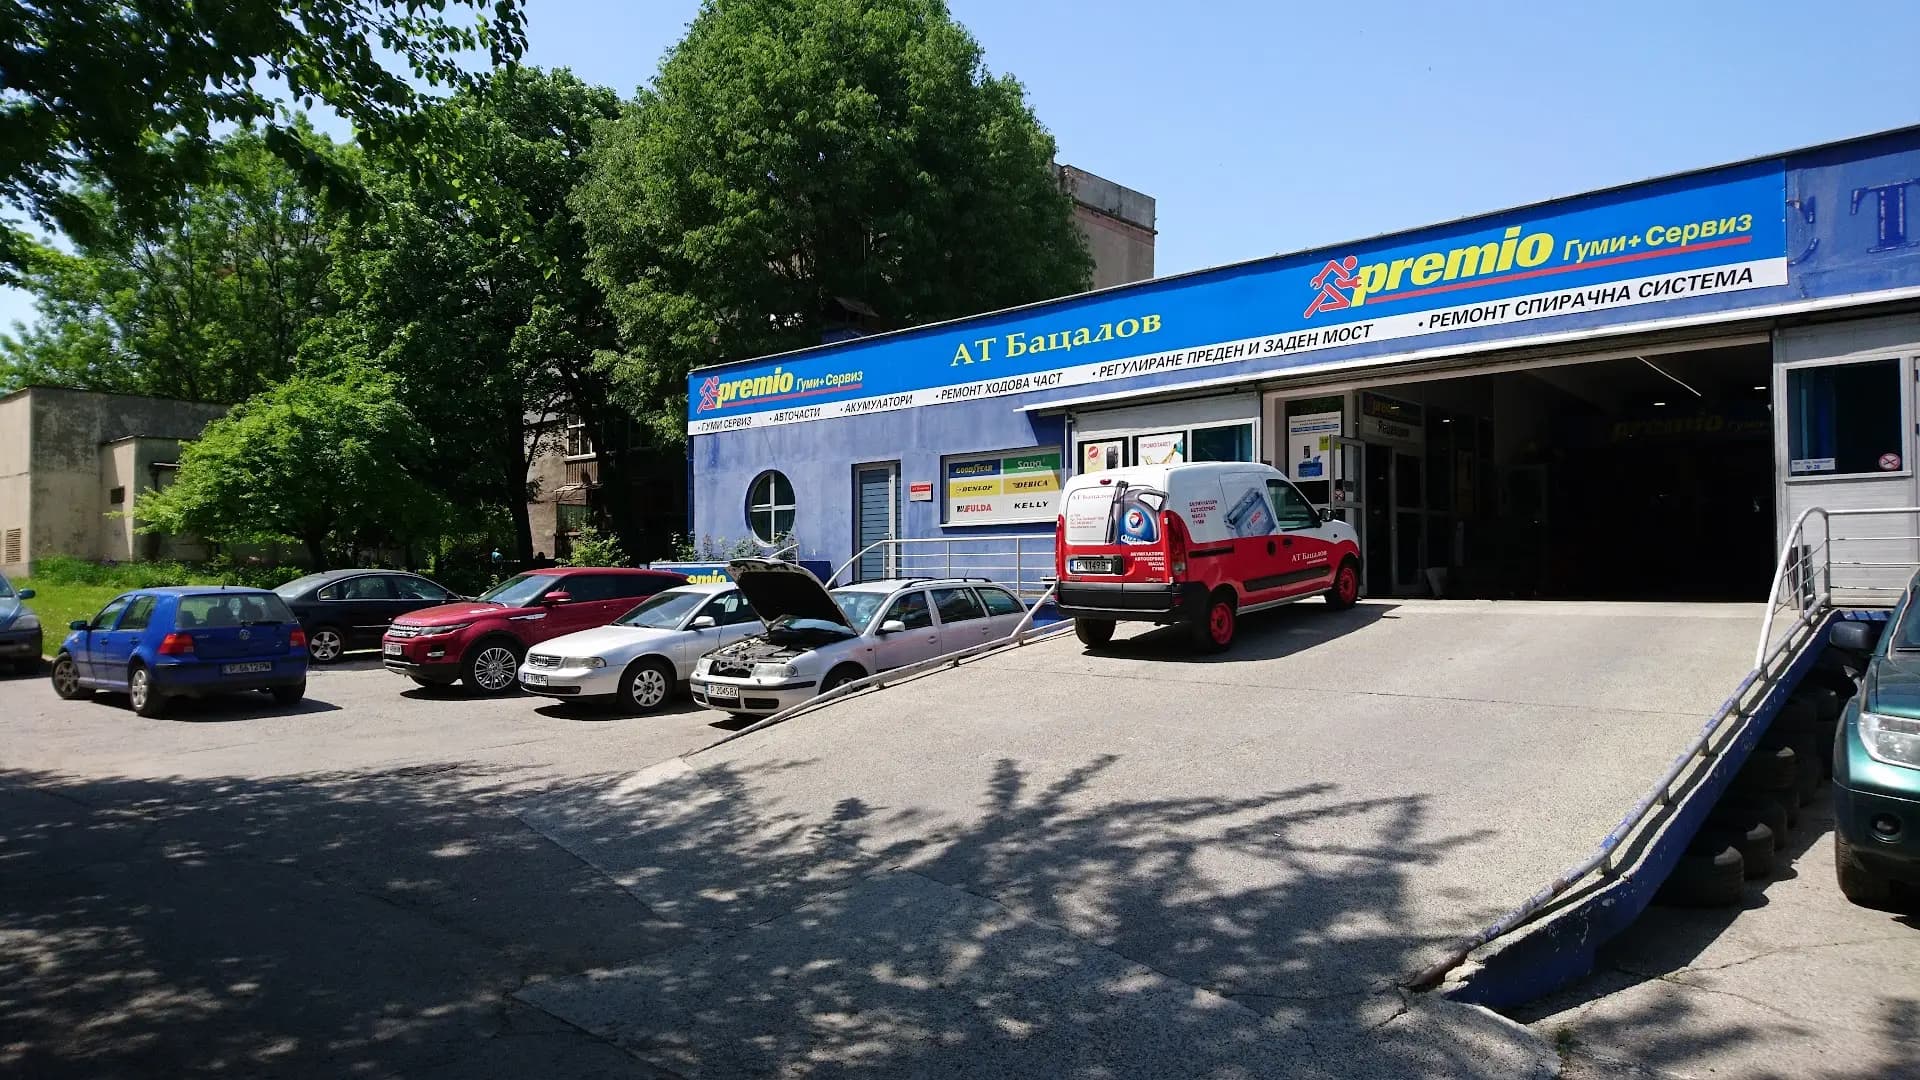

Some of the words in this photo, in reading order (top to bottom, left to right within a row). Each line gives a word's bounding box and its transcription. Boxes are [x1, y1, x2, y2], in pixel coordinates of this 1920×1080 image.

[1350, 227, 1555, 307] premio
[1429, 303, 1510, 329] РЕМОНТ
[1515, 285, 1631, 317] СПИРАЧНА
[1637, 267, 1753, 299] СИСТЕМА
[951, 337, 996, 367] АТ
[1005, 314, 1161, 358] Бацалов
[1099, 353, 1184, 378] РЕГУЛИРАНЕ
[1187, 343, 1244, 365] ПРЕДЕН
[1248, 341, 1260, 355] И
[1263, 333, 1318, 353] ЗАДЕН
[1322, 323, 1374, 344] МОСТ
[717, 366, 794, 409] premio
[941, 385, 983, 400] РЕМОНТ
[985, 378, 1030, 394] ХОДОВА
[1033, 372, 1063, 387] ЧАСТ
[844, 394, 913, 413] АКУМУЛАТОРИ
[701, 420, 722, 432] ГУМИ
[723, 416, 752, 429] СЕРВИЗ
[773, 407, 821, 423] АВТОЧАСТИ
[961, 485, 993, 493] DUNLOP
[965, 504, 992, 513] FULDA
[1014, 501, 1049, 509] KELLY
[686, 569, 727, 584] emio
